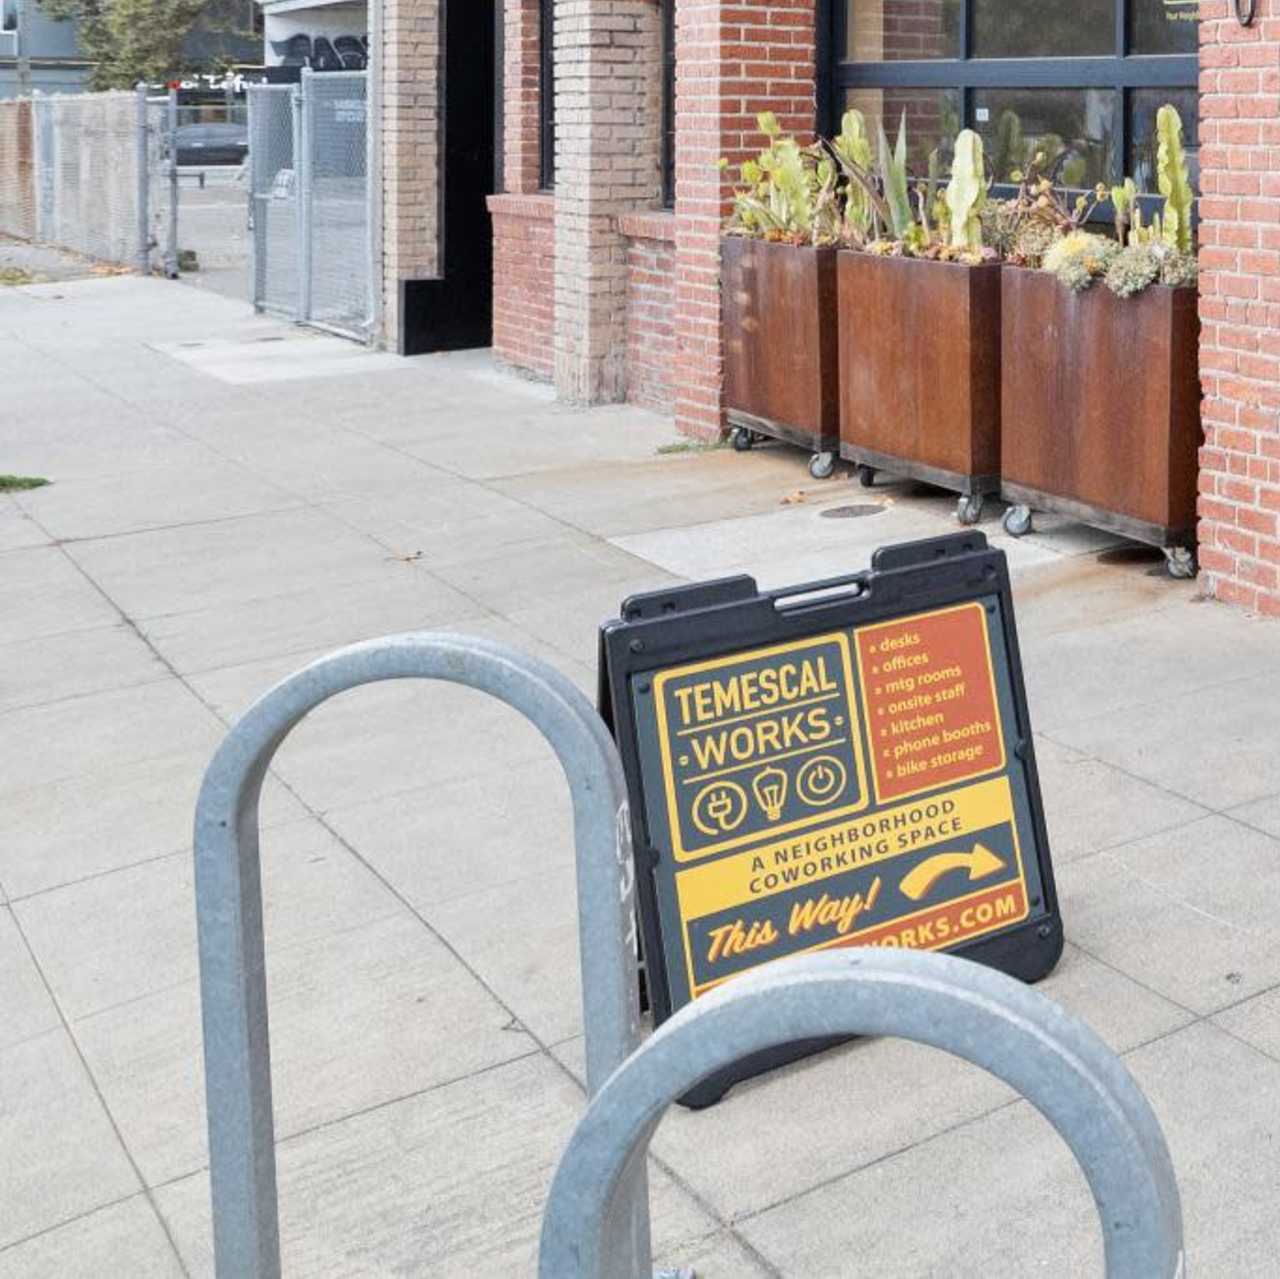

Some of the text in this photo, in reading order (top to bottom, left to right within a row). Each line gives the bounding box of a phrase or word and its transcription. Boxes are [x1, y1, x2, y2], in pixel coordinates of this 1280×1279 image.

[880, 633, 921, 652] desks
[883, 653, 929, 672] offices
[885, 665, 962, 694] mtg rooms
[674, 656, 837, 725] TEMESCAL
[888, 682, 966, 714] onsite staff
[691, 708, 831, 770] WORKS
[891, 712, 944, 735] kitchen
[894, 721, 992, 760] phone booths
[896, 744, 984, 777] bike storage
[751, 799, 956, 873] A NEIGHBORHOOD
[749, 817, 963, 894] COWORKING SPACE
[707, 876, 881, 963] This Way!
